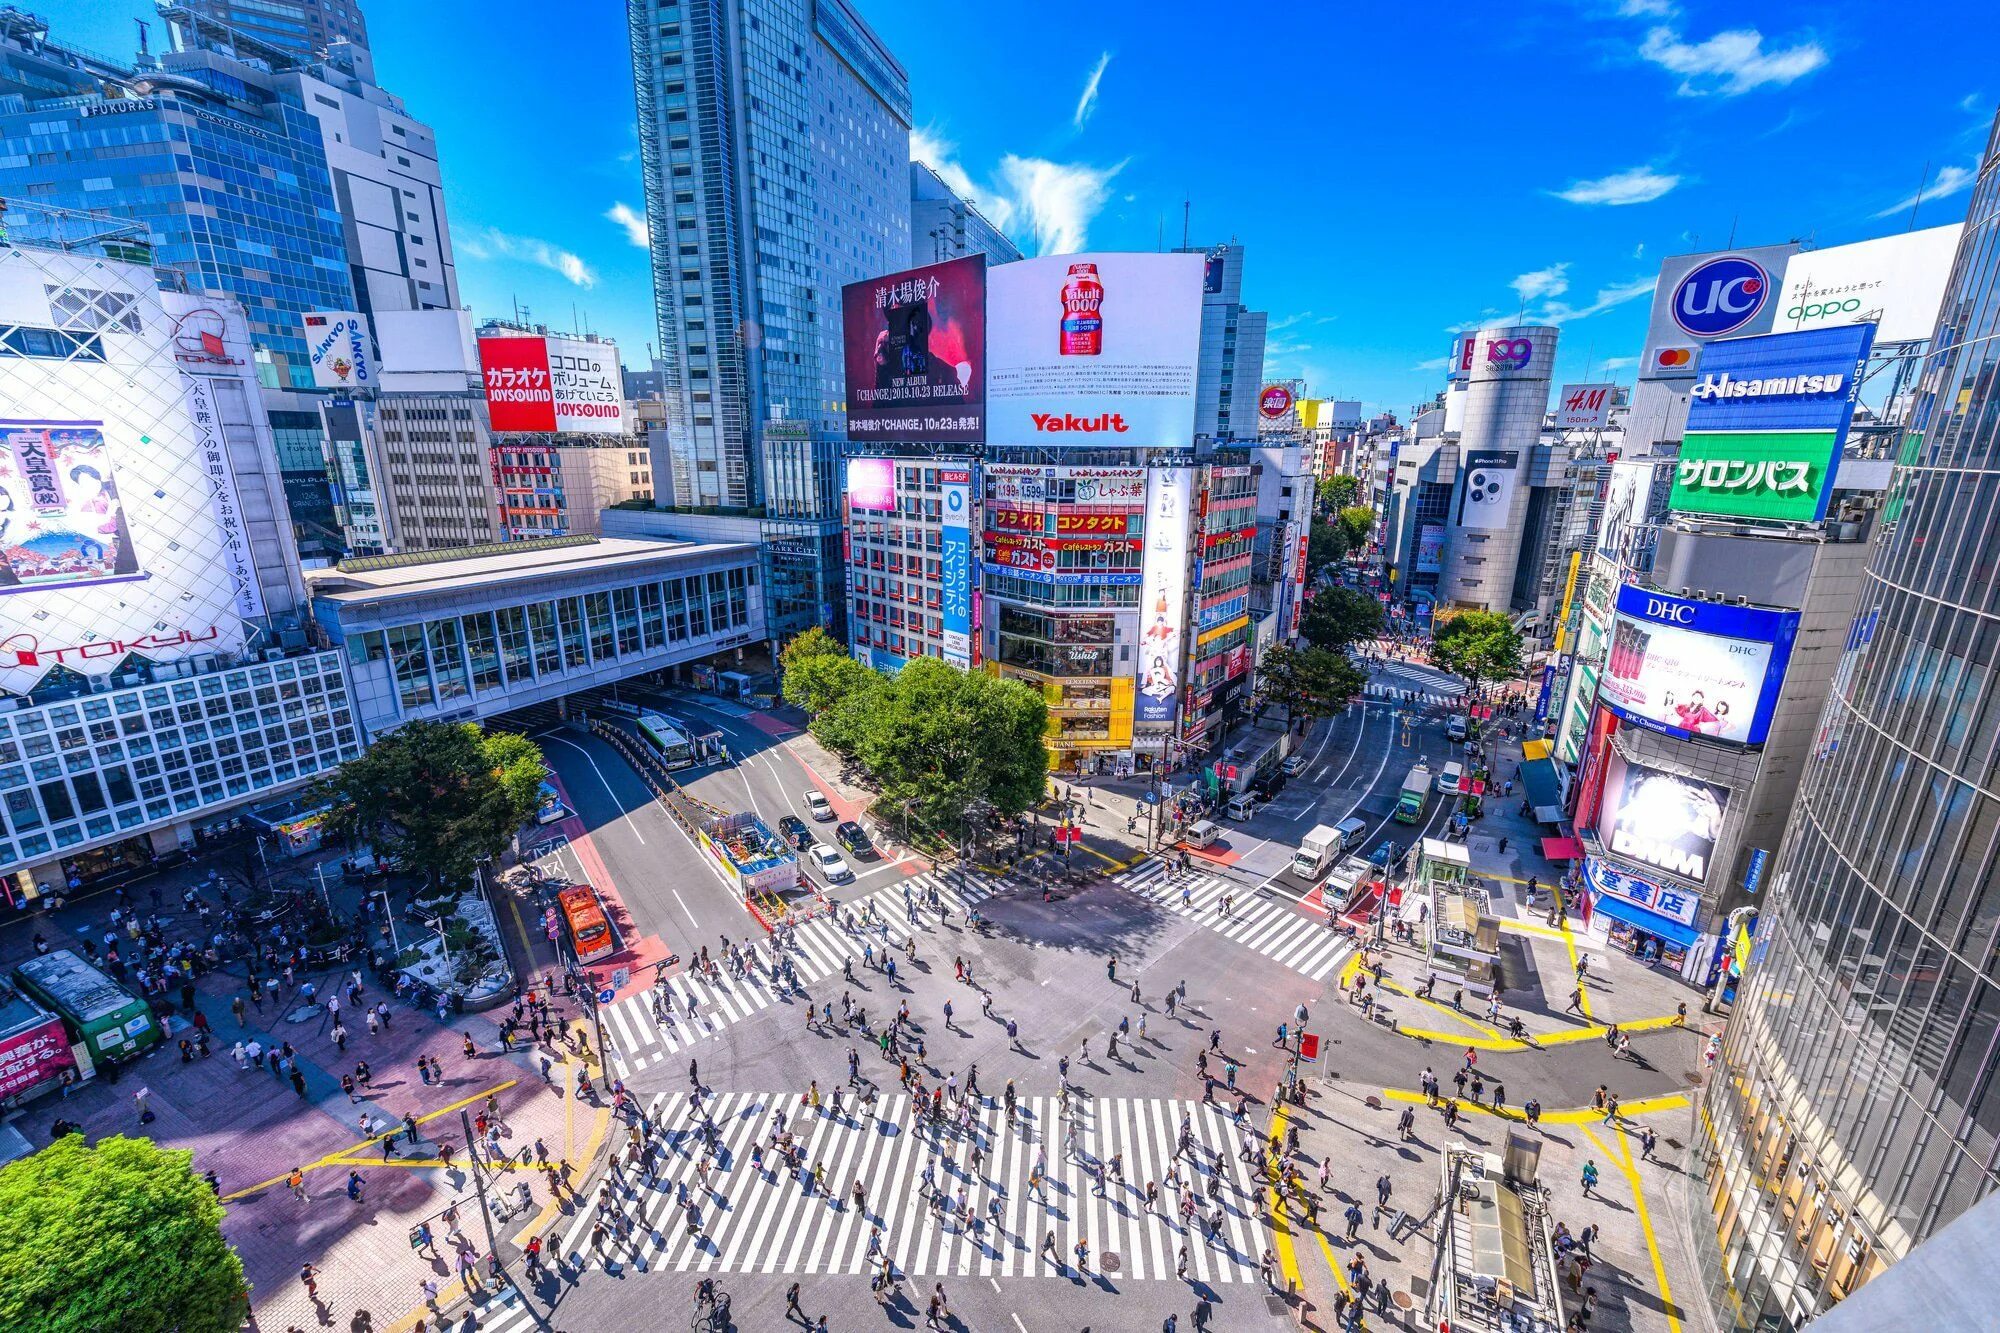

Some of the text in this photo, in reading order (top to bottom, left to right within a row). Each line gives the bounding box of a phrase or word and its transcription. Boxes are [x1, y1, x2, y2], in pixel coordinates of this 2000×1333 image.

[92, 101, 154, 116] FUKURAS
[194, 108, 268, 139] TOKYU PLAZA
[875, 275, 940, 309] 清木場俊介
[1065, 287, 1101, 299] Yakult
[1683, 276, 1757, 315] UC
[1065, 298, 1099, 312] 1000
[1787, 298, 1861, 321] oppo
[312, 321, 345, 365] SANKYO
[346, 319, 368, 380] SANKYO
[175, 354, 245, 365] TOKYU
[1486, 338, 1533, 371] 109
[550, 354, 601, 373] ココロの
[487, 367, 547, 387] カラオケ
[553, 371, 616, 390] ボリューム、
[892, 376, 927, 387] NEW ALBUM
[1690, 372, 1843, 399] Hisamitsu
[1847, 359, 1865, 402] サロンパス
[490, 388, 551, 402] JOYSOUND
[555, 388, 619, 403] あげていこう。
[933, 384, 969, 397] RELEASE
[1565, 388, 1607, 412] H&M
[556, 402, 620, 418] JOYSOUND
[1031, 413, 1130, 433] Yakult
[1069, 469, 1143, 478] しゃぶしゃぶバイキング
[1679, 459, 1810, 492] サロンパス
[987, 482, 996, 492] 9F
[1099, 482, 1143, 497] しゃぶ葉
[997, 511, 1043, 528] プライス
[1058, 516, 1125, 530] コンタクト
[1023, 538, 1047, 550] ガスト
[1104, 541, 1135, 553] ガスト
[986, 549, 996, 557] 7F
[1011, 550, 1039, 567] ガスト
[945, 540, 957, 616] アイシティ
[957, 541, 967, 618] コンタクトの
[1083, 575, 1140, 584] 英会話イーオン
[1646, 598, 1695, 624] DHC
[38, 626, 218, 663] TOKYU
[1729, 645, 1757, 656] DHC
[1226, 684, 1241, 699] LUSH
[1625, 712, 1667, 733] DHC Channel
